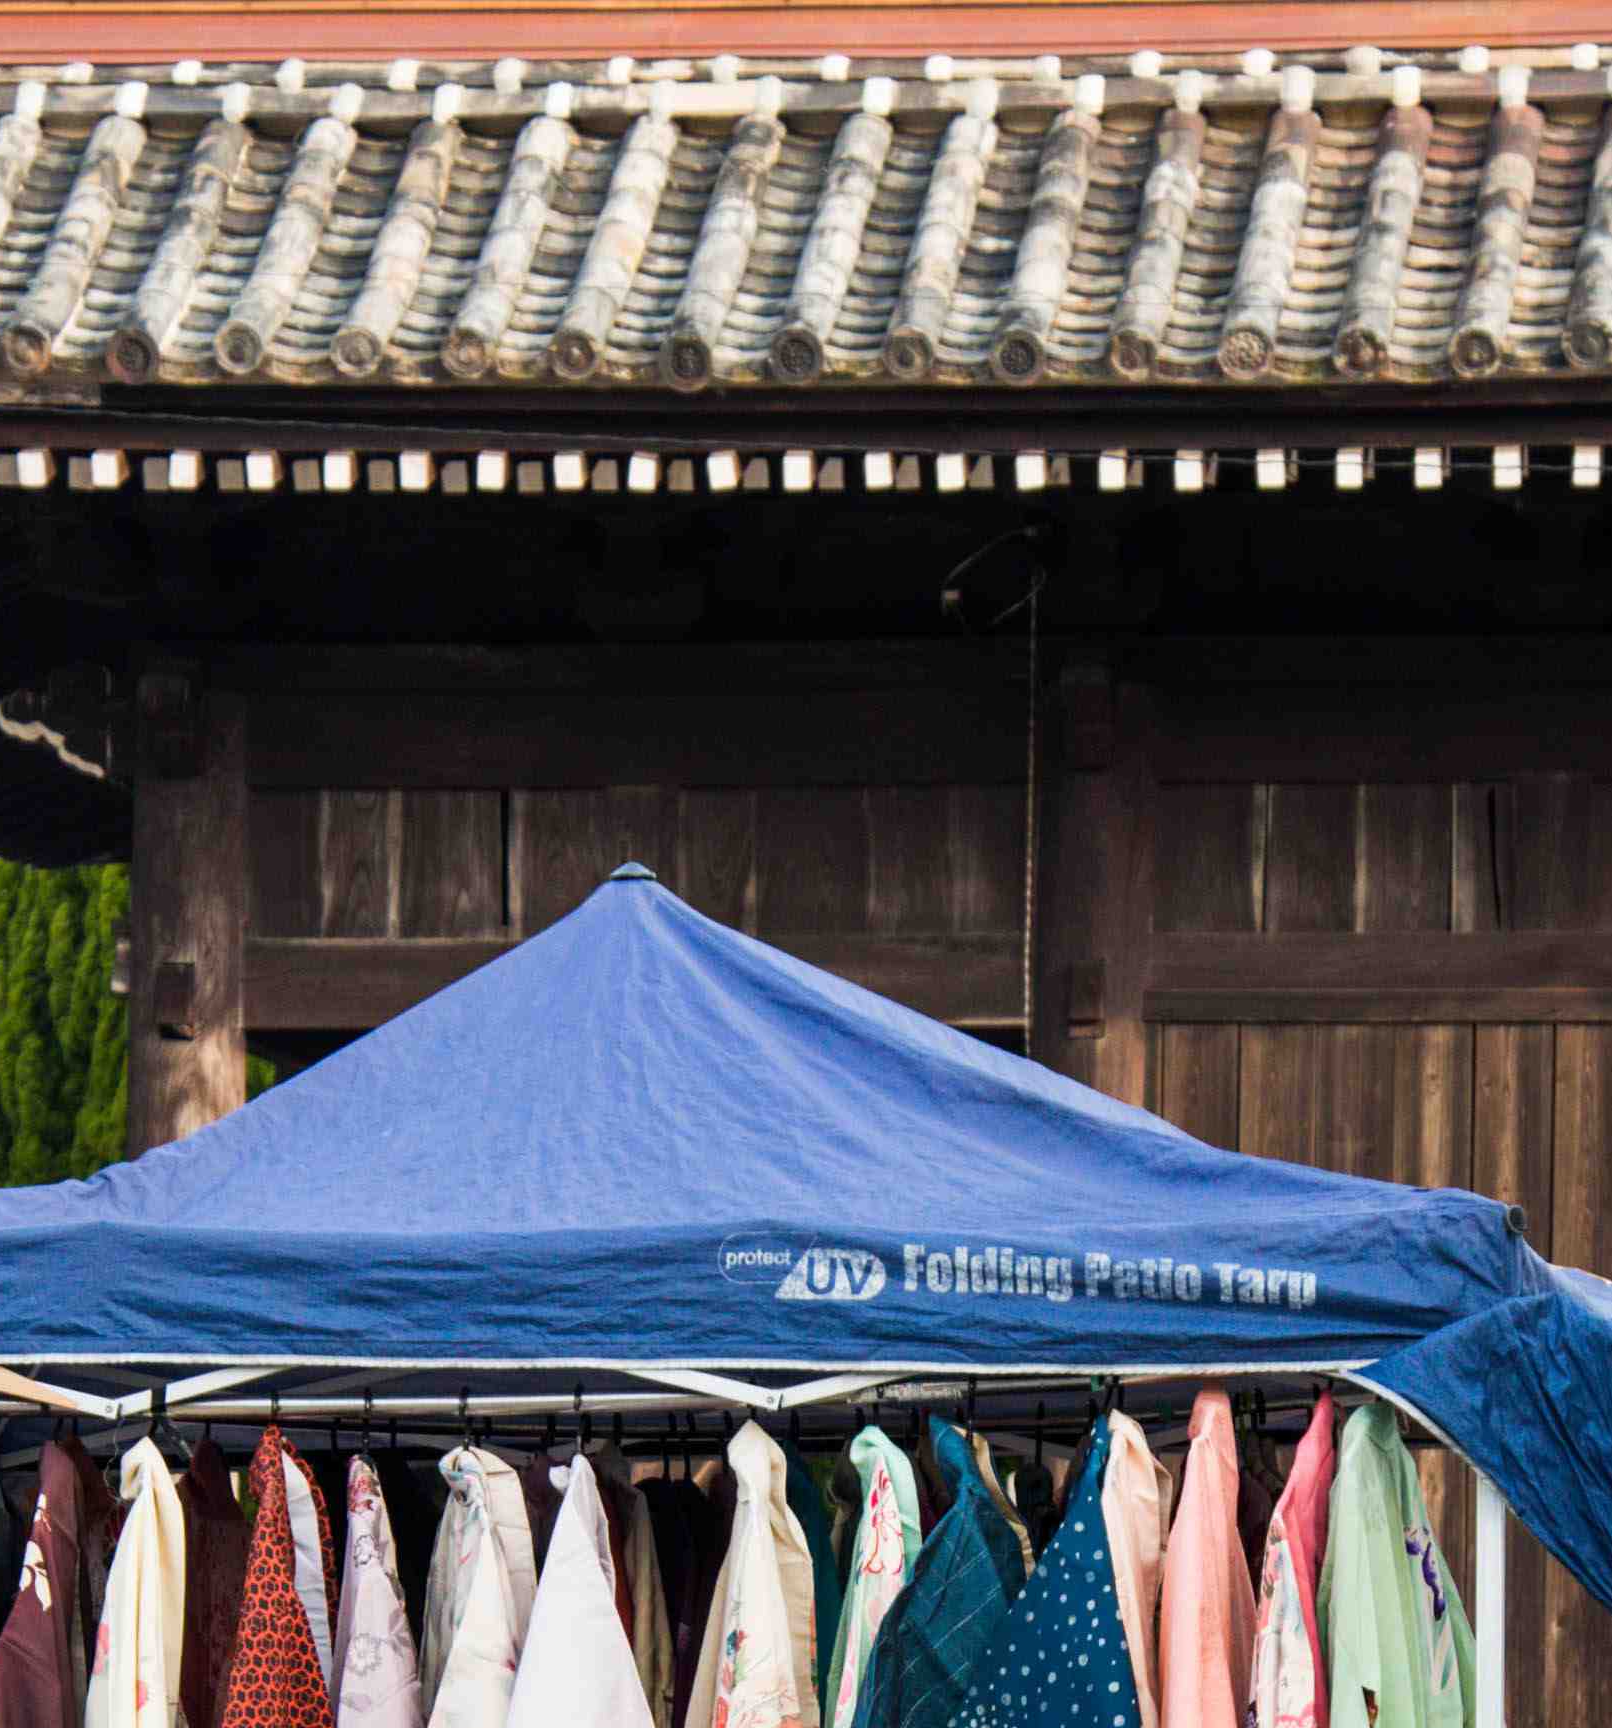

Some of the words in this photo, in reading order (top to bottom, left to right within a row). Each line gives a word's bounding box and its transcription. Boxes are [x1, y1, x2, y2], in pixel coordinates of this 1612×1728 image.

[725, 1248, 792, 1270] protect
[805, 1253, 875, 1296] UV
[902, 1243, 1074, 1302] Folding
[1084, 1252, 1202, 1302] Patio
[1211, 1262, 1318, 1310] Tarp
